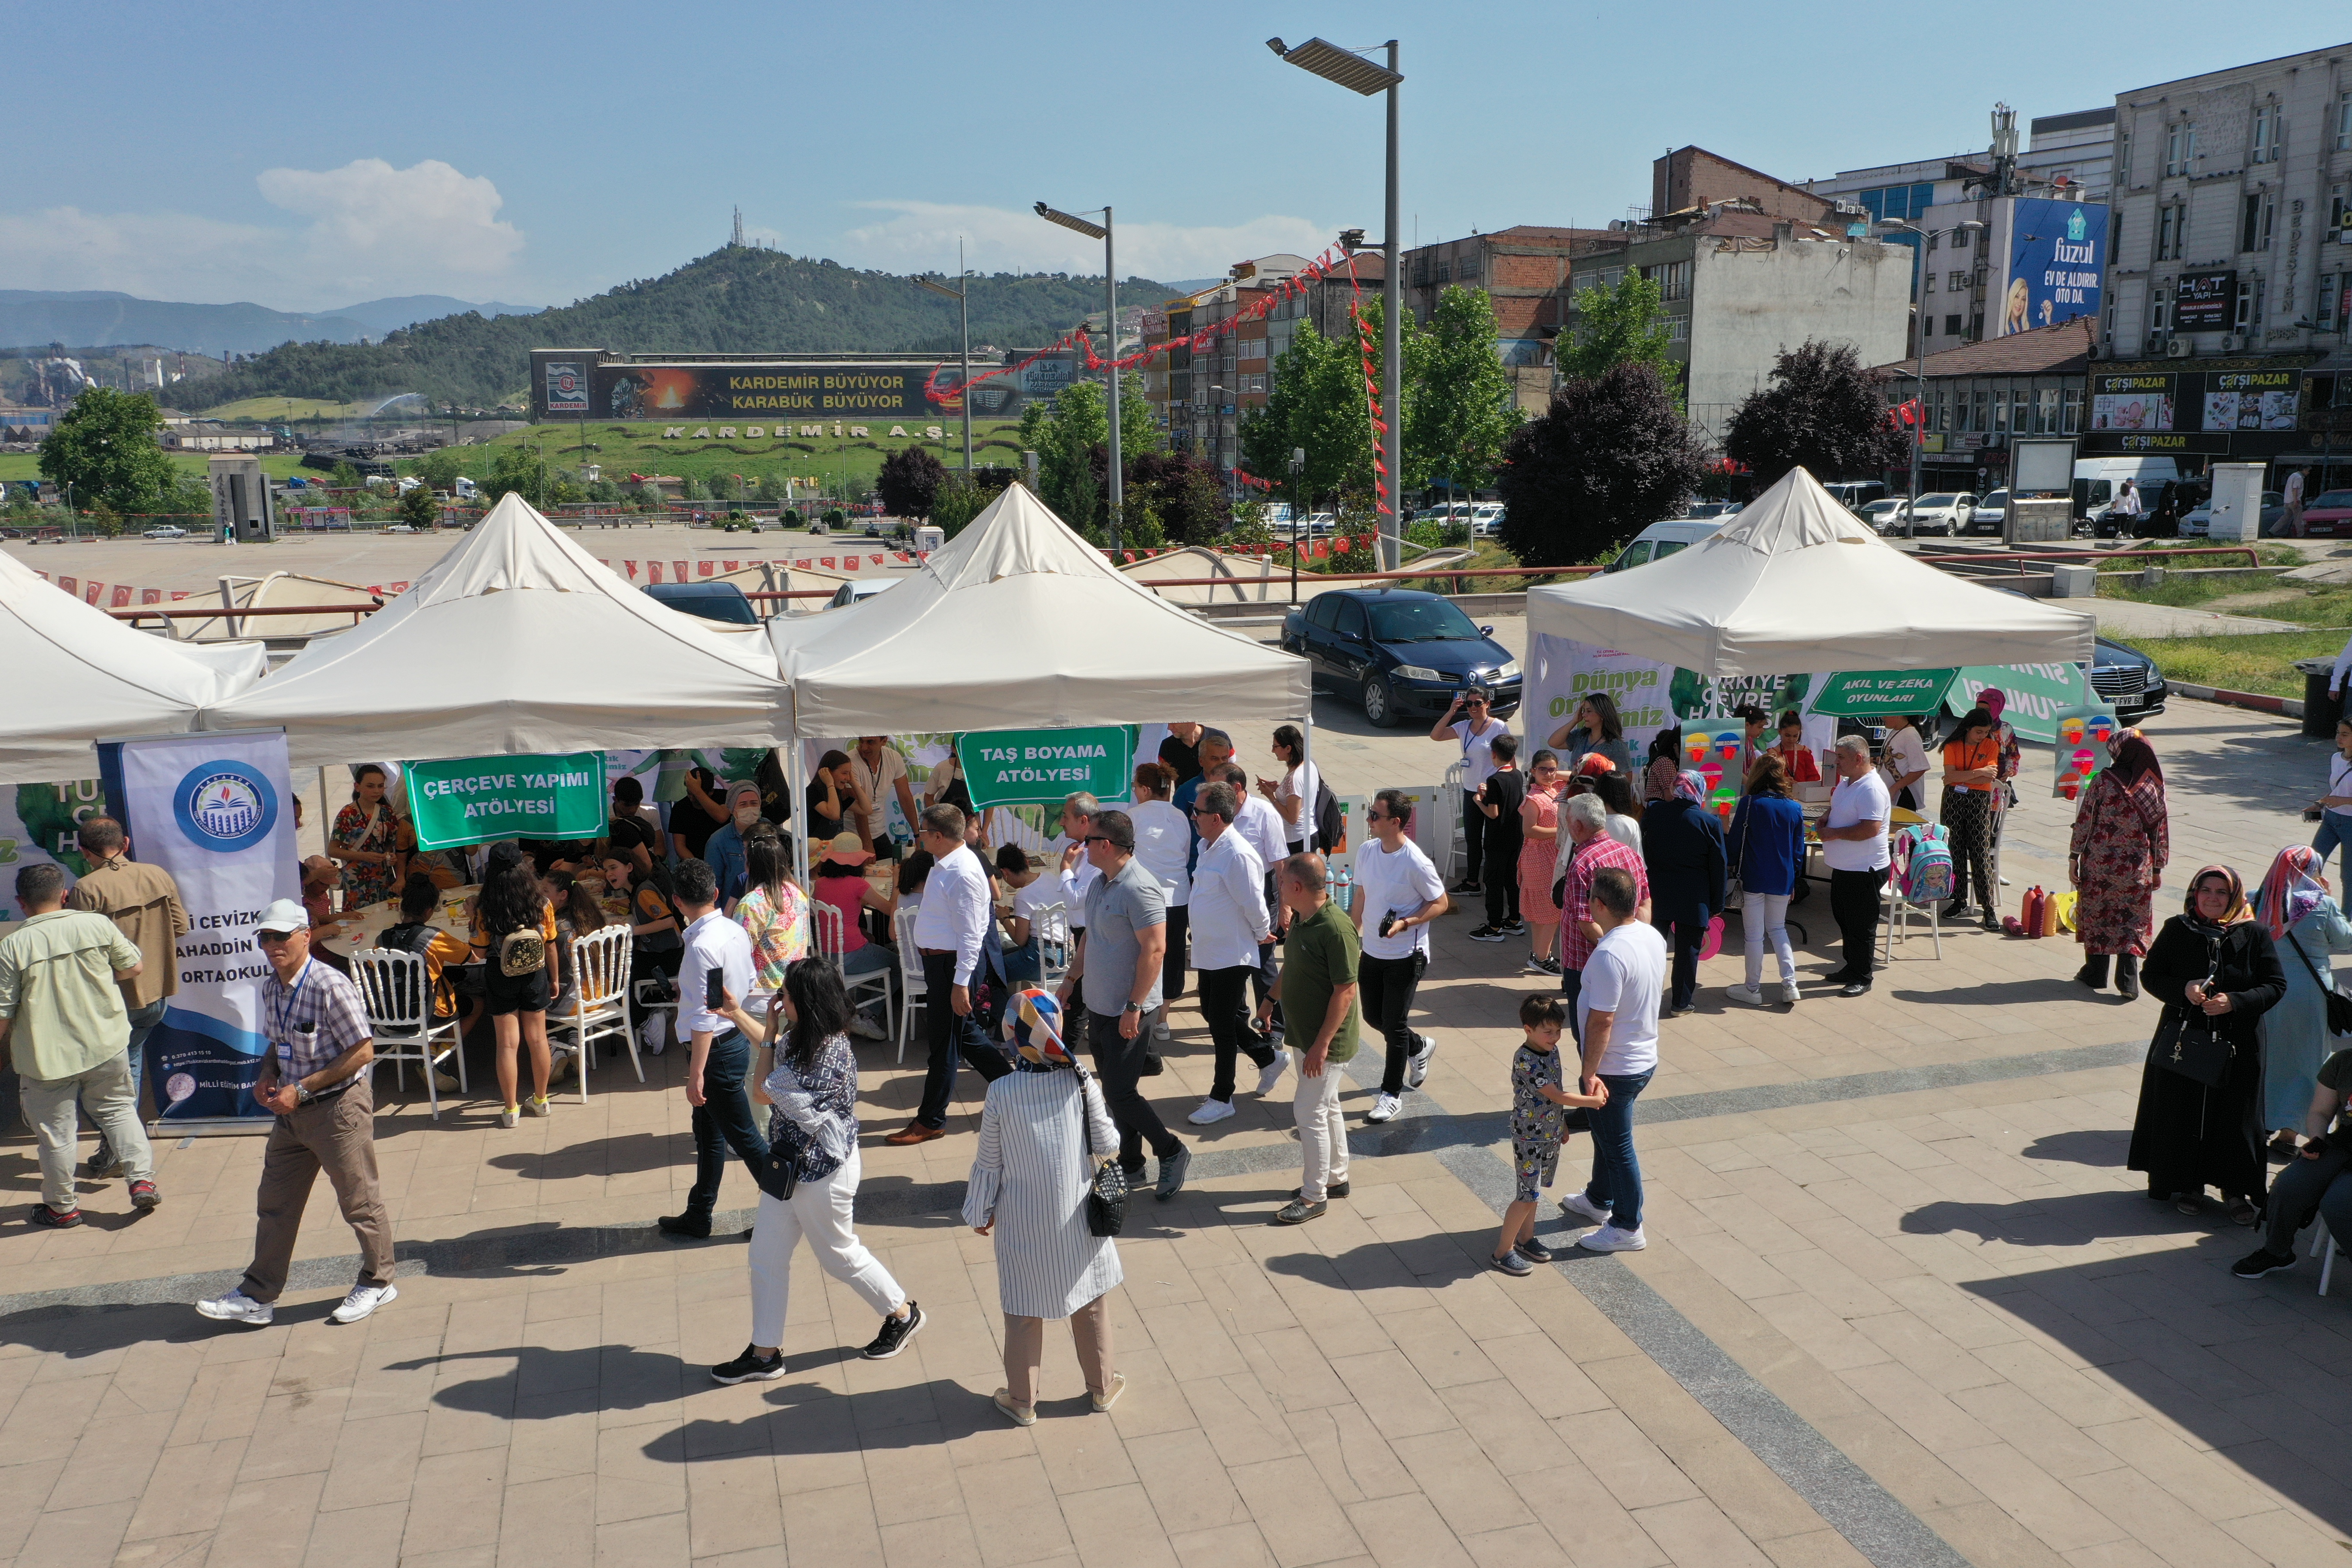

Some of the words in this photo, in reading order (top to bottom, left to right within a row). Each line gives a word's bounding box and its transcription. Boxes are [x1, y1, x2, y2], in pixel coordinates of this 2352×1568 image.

[2053, 237, 2094, 264] fuzul
[2281, 199, 2304, 312] BEDESTEN
[2045, 270, 2055, 286] EV
[2056, 271, 2066, 287] DE
[2067, 272, 2098, 288] ALDIRIR.
[2179, 276, 2226, 293] HAT
[2055, 288, 2070, 303] OTO
[2072, 289, 2084, 304] DA.
[2193, 291, 2211, 300] YAPI
[730, 373, 819, 389] KARDEMİR
[824, 373, 903, 389] BÜYÜYOR
[733, 392, 814, 409] KARABÜK
[823, 392, 902, 408] BÜYÜYOR
[663, 420, 869, 438] KARDEMİR
[889, 426, 952, 440] A.Ş.
[1570, 669, 1658, 694] Dünya
[1842, 680, 1872, 691] AKIL
[1878, 680, 1896, 689] VE
[1896, 679, 1933, 689] ZEKA
[1847, 694, 1915, 704] OYUNLARI
[1879, 729, 1886, 737] 78
[980, 747, 1018, 764] TAŞ
[1024, 744, 1107, 760] BOYAMA
[199, 775, 251, 790] KARABÜK
[995, 765, 1090, 783] ATÖLYESİ
[423, 774, 516, 800] ÇERÇEVE
[521, 772, 589, 788] YAPIMI
[464, 796, 554, 818] ATÖLYESİ
[199, 910, 262, 929] CEVİZK
[176, 937, 253, 959] AHADDİN
[181, 965, 274, 983] ORTAOKUL
[199, 1080, 219, 1088] MİLLİ
[220, 1080, 239, 1090] EĞİTİM
[241, 1080, 257, 1090] BAK
